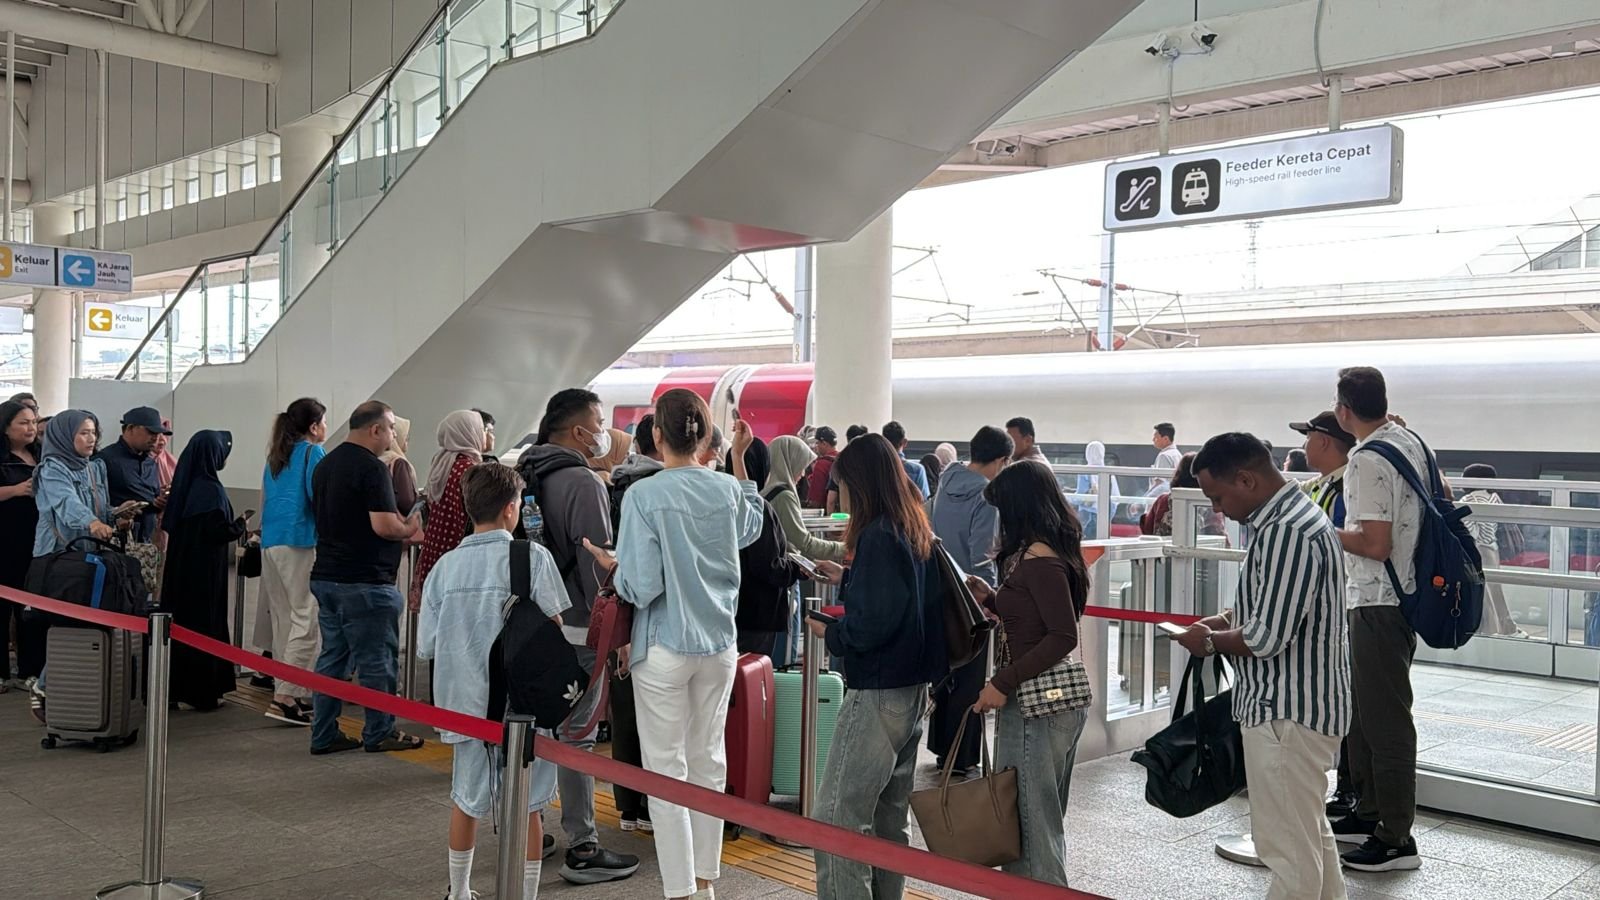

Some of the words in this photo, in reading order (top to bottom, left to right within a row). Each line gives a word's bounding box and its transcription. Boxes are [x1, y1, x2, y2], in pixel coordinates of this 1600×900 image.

[1226, 158, 1273, 173] Feeder
[1276, 152, 1323, 166] Kereta
[1327, 144, 1371, 160] Cepat
[1225, 173, 1275, 187] High-speed
[1277, 169, 1291, 180] rail
[1293, 166, 1322, 178] feeder
[1325, 165, 1341, 174] line
[14, 254, 50, 265] Keluar
[14, 265, 28, 273] Exit
[109, 263, 129, 271] Jarak
[115, 313, 143, 322] Keluar
